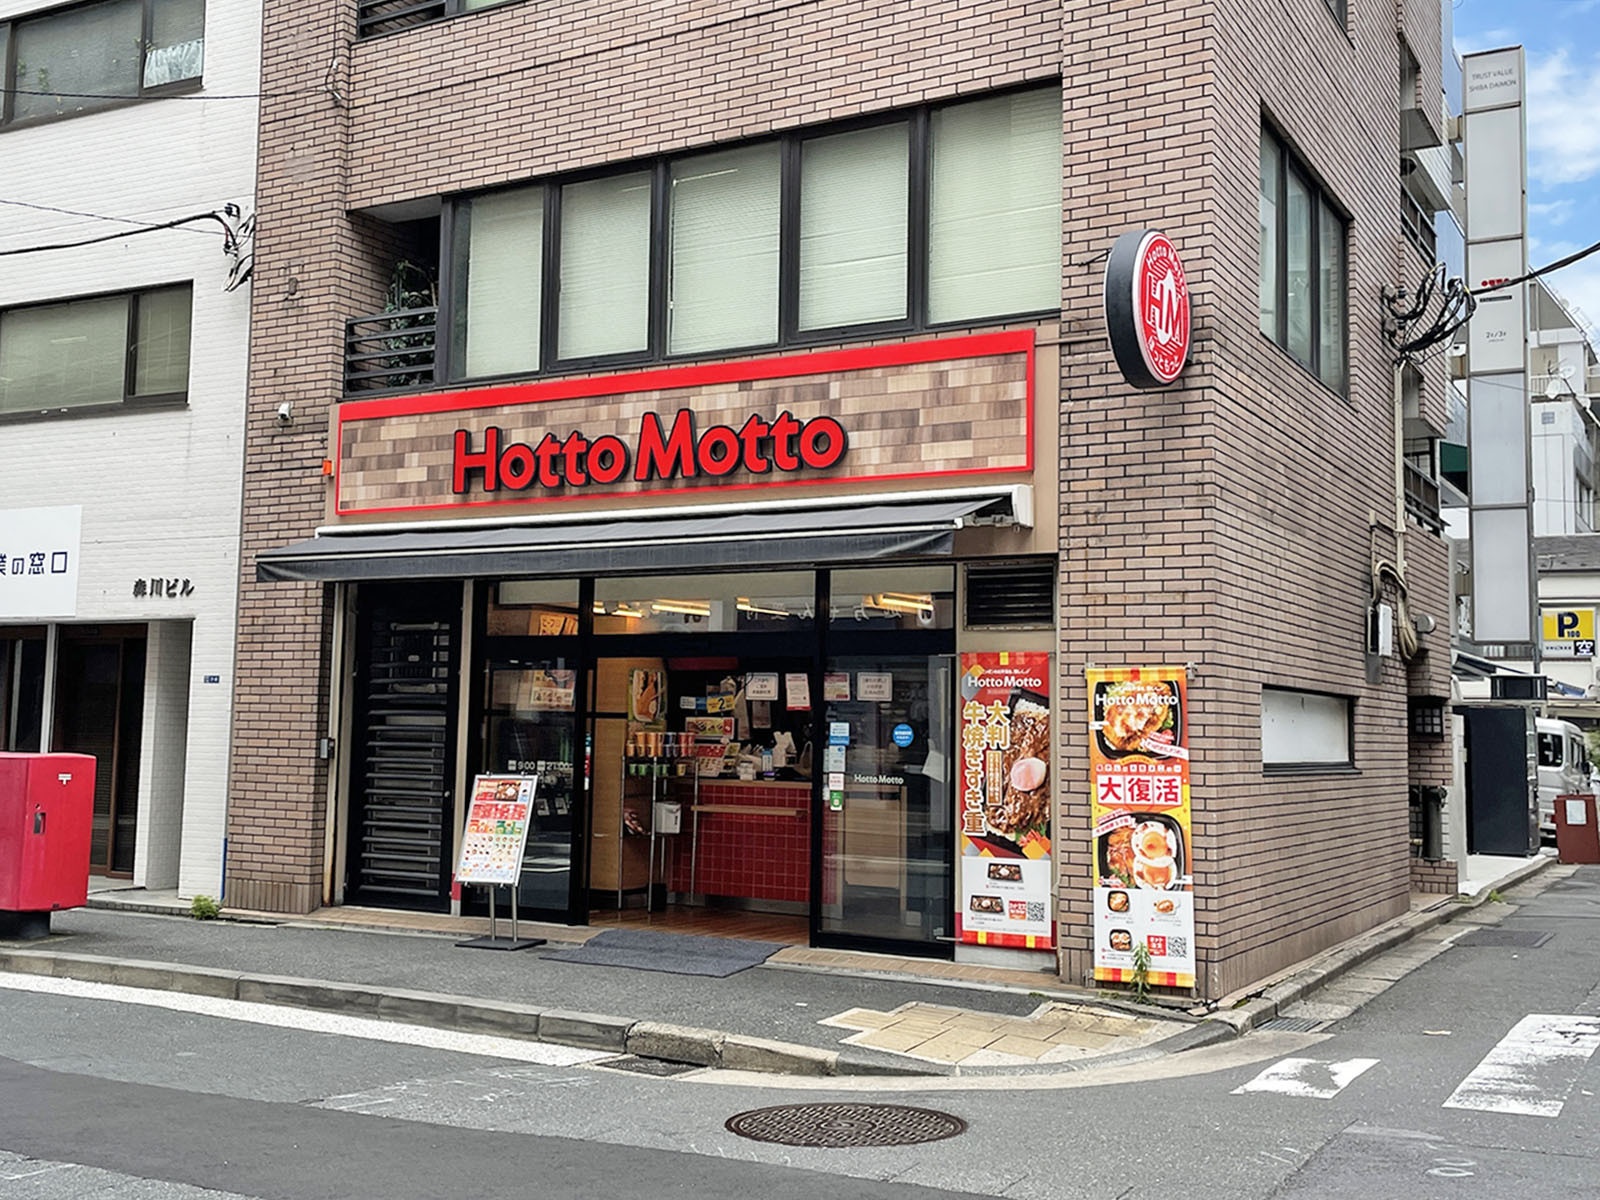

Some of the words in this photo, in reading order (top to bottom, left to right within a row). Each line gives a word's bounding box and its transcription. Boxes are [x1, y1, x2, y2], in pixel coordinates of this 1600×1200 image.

[1472, 71, 1491, 80] TRUST
[1493, 68, 1513, 77] VALUE
[1469, 83, 1488, 92] SHIBA
[1489, 80, 1516, 89] DAIMON
[453, 425, 630, 494] Hotto
[634, 407, 848, 482] Motto
[1558, 612, 1579, 637] P
[1576, 640, 1593, 655] 空
[968, 676, 1003, 687] Hotto
[1004, 676, 1042, 687] Motto
[1095, 693, 1135, 706] Hotto
[1136, 693, 1178, 706] Motto
[987, 701, 1010, 749] 大判
[964, 701, 986, 835] 牛焼きすき重
[854, 774, 877, 784] Hotto
[878, 774, 904, 785] Motto
[1100, 776, 1179, 803] 大復活
